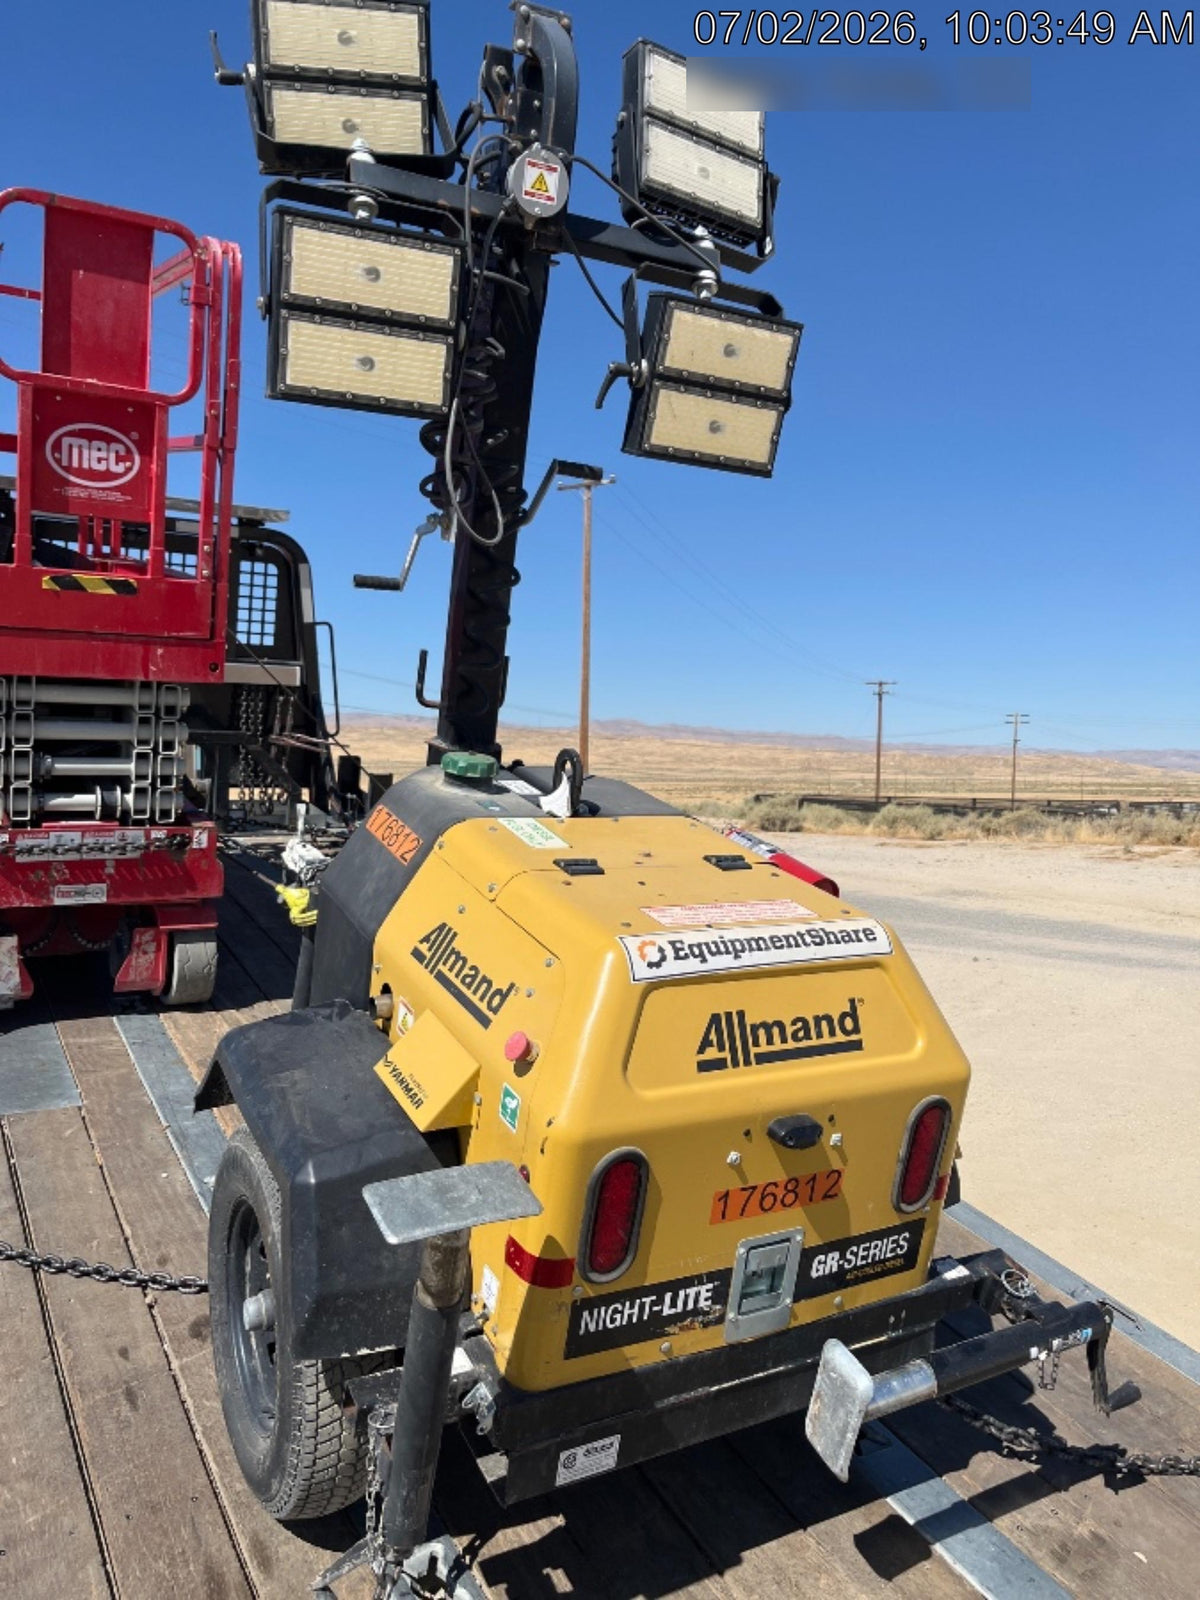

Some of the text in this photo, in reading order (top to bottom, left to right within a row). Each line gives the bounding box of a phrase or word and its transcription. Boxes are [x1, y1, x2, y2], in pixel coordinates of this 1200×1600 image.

[369, 806, 421, 863] 176812
[418, 922, 516, 1016] Allmand
[668, 925, 878, 962] EquipmentShare
[696, 997, 862, 1068] Allmand
[389, 1064, 424, 1110] YANMAR
[717, 1169, 843, 1220] 176812
[810, 1231, 910, 1279] GR-SERIES
[579, 1283, 714, 1336] NIGHT-LITE
